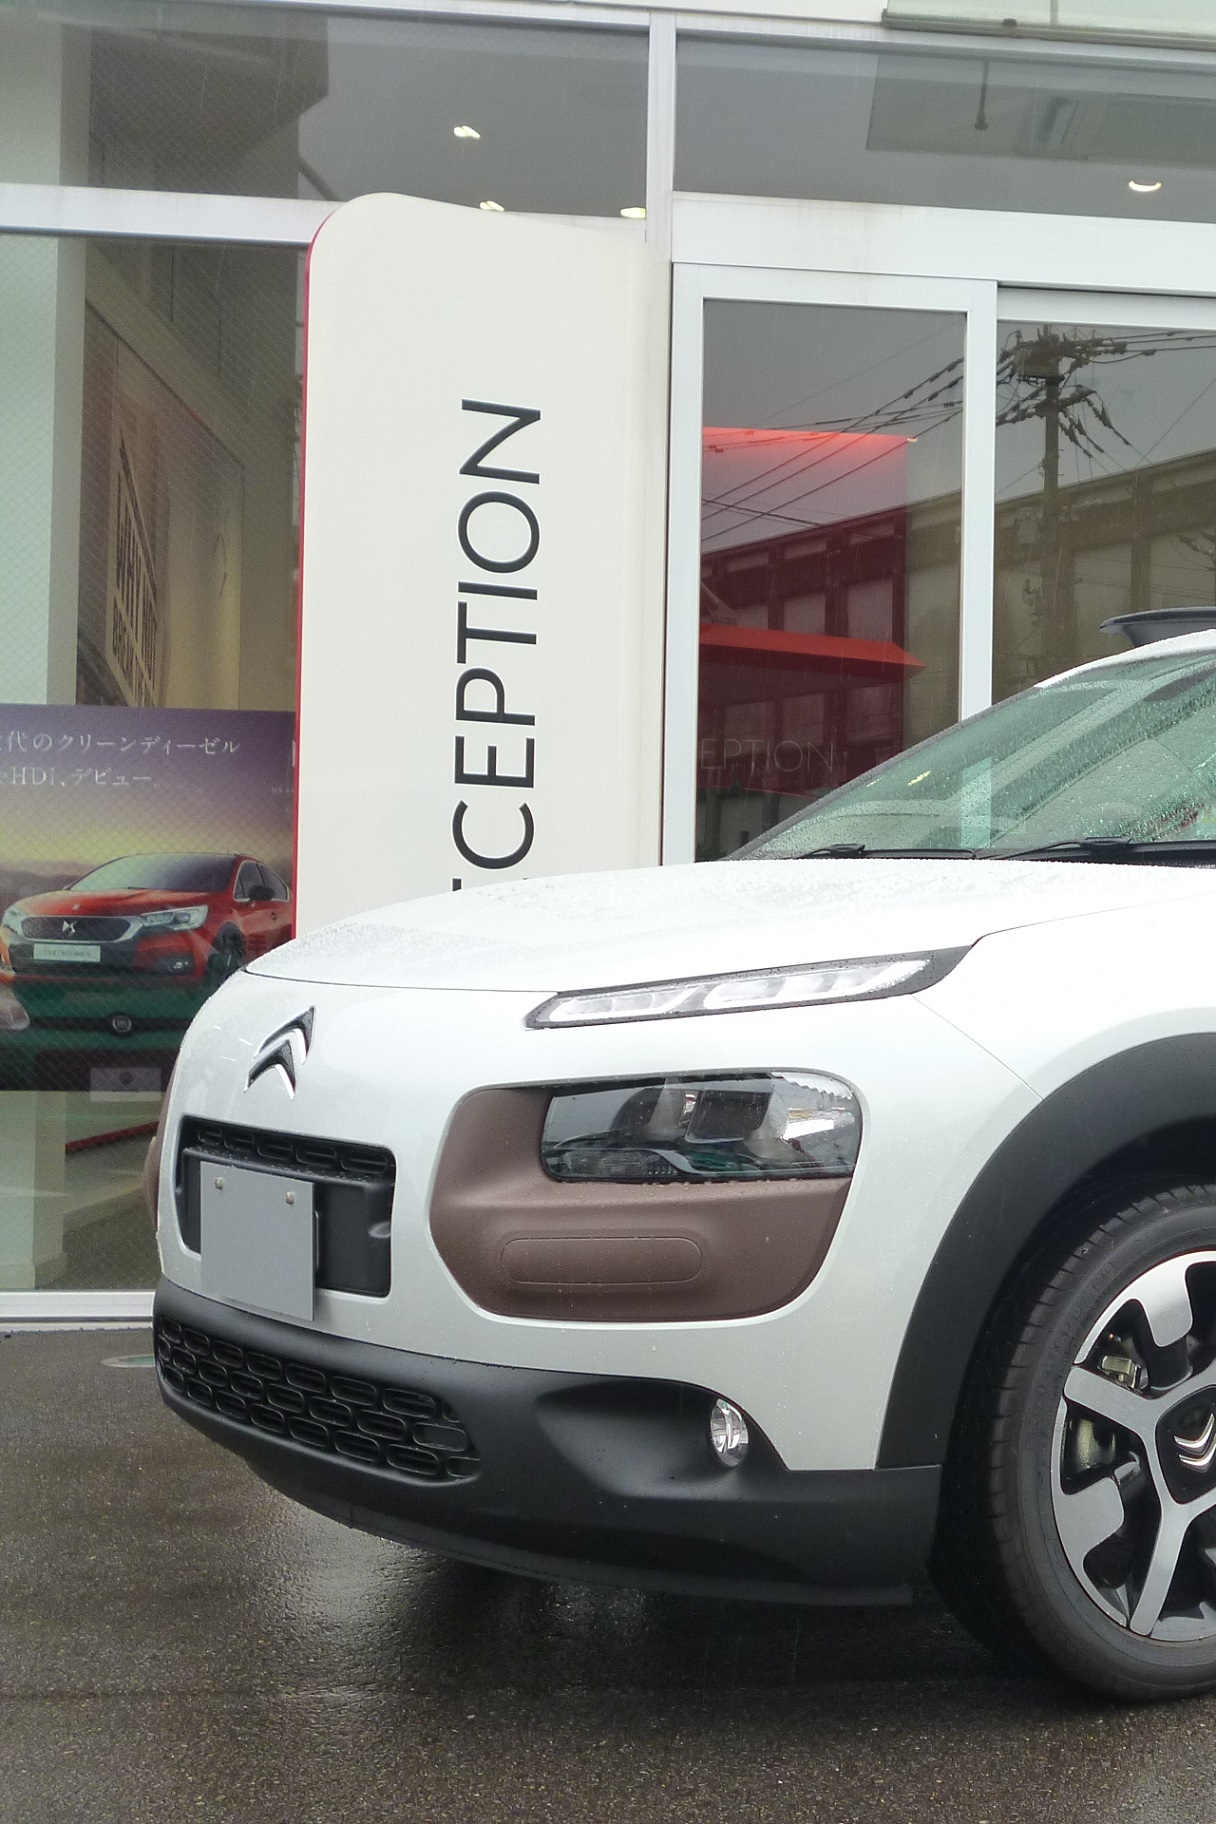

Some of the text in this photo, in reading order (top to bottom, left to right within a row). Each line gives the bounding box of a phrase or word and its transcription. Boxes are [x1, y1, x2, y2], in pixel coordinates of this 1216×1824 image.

[0, 730, 240, 755] 代のクリーンディーゼル
[450, 398, 541, 891] CEPTION
